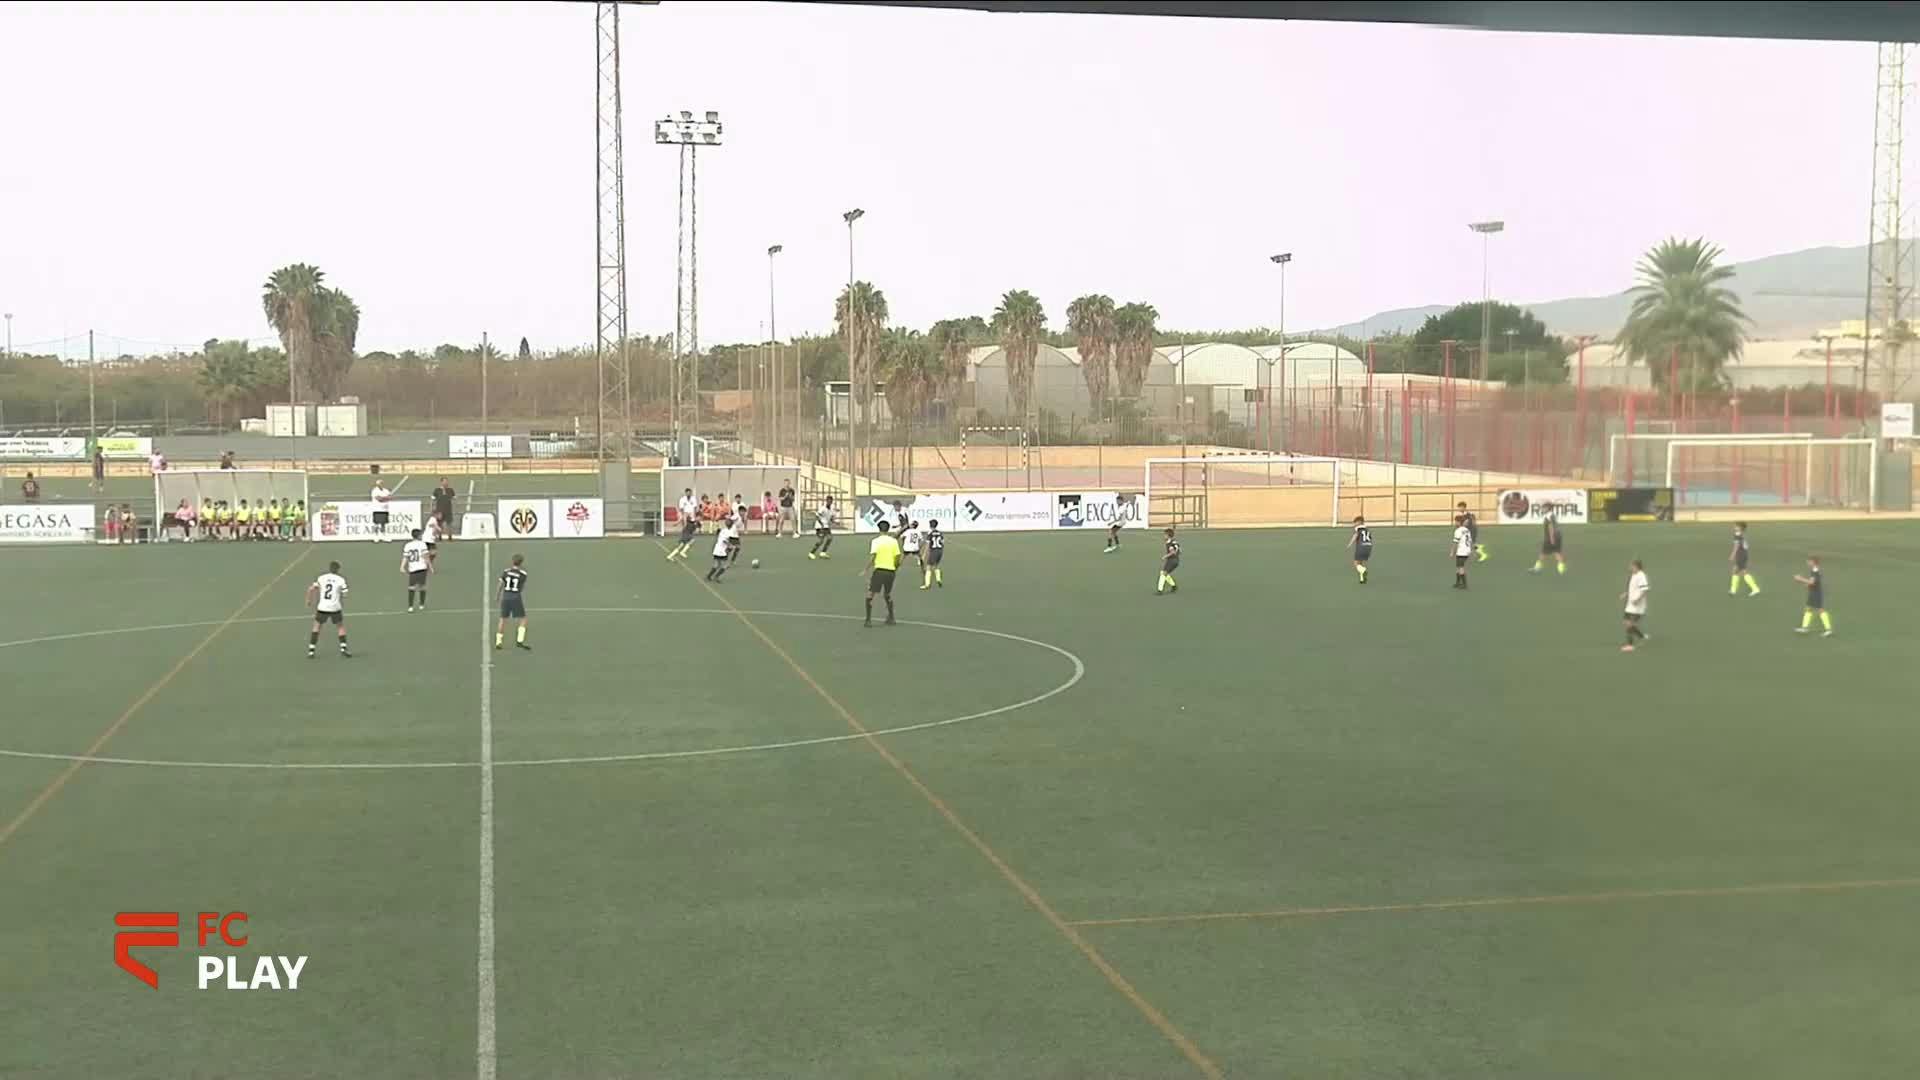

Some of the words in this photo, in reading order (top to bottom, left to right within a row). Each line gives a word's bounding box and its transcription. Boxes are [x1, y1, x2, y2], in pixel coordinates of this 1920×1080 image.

[1086, 502, 1142, 521] EXCAOL
[0, 514, 72, 528] EGASA
[408, 549, 419, 562] 20
[324, 583, 333, 599] 2
[505, 576, 519, 591] 11
